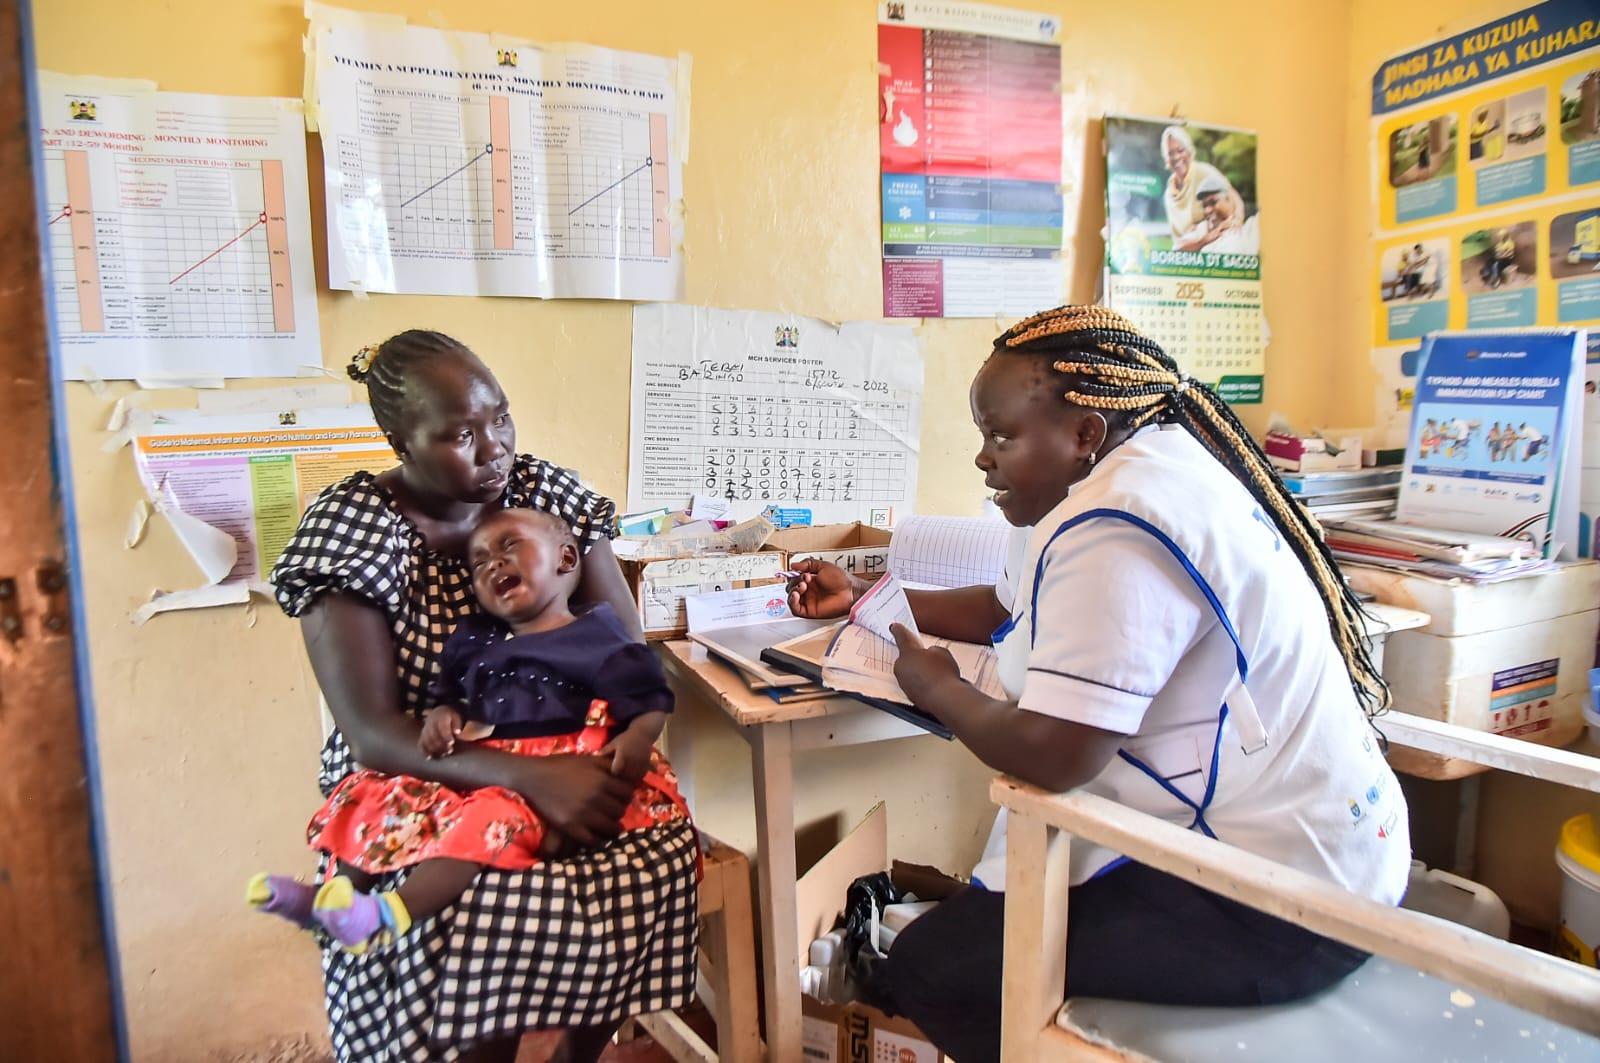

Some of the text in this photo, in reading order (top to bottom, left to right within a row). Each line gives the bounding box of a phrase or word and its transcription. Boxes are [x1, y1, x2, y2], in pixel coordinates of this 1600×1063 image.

[1381, 14, 1539, 92] JINSI ZA KUZUIA
[334, 55, 382, 71] VITAMIN
[396, 65, 503, 82] SUPPLEMENTATION
[513, 76, 563, 88] MONTHLY
[566, 81, 630, 95] MONITORING
[633, 90, 664, 100] CHART
[1384, 61, 1480, 107] MADHARA
[1484, 50, 1510, 74] YA
[54, 128, 268, 148] AND DEWORMING MONTHLY MONITORING
[1151, 251, 1204, 267] BORESHA
[1222, 255, 1259, 270] SACCO
[1115, 282, 1259, 299] SEPTEMBER 2025 OCTOBER
[764, 356, 797, 364] SERVICES
[863, 380, 889, 394] 2023
[1426, 375, 1560, 389] TYPHOID AND MEASLES RUBELLA
[1516, 389, 1546, 400] CHART
[248, 435, 270, 445] Young
[270, 433, 288, 443] Child
[289, 432, 316, 441] Nutrition
[711, 425, 720, 436] 5
[728, 426, 739, 436] 3
[849, 431, 858, 439] 2
[705, 455, 720, 466] 2
[726, 454, 736, 465] 0
[812, 459, 822, 467] 2
[705, 467, 717, 478] 3
[724, 468, 734, 477] 4
[759, 468, 770, 476] 0
[780, 468, 788, 480] 0
[790, 468, 805, 481] 7
[705, 478, 716, 489] 0
[759, 480, 770, 490] 0
[779, 480, 788, 490] 0
[742, 488, 752, 500] 0
